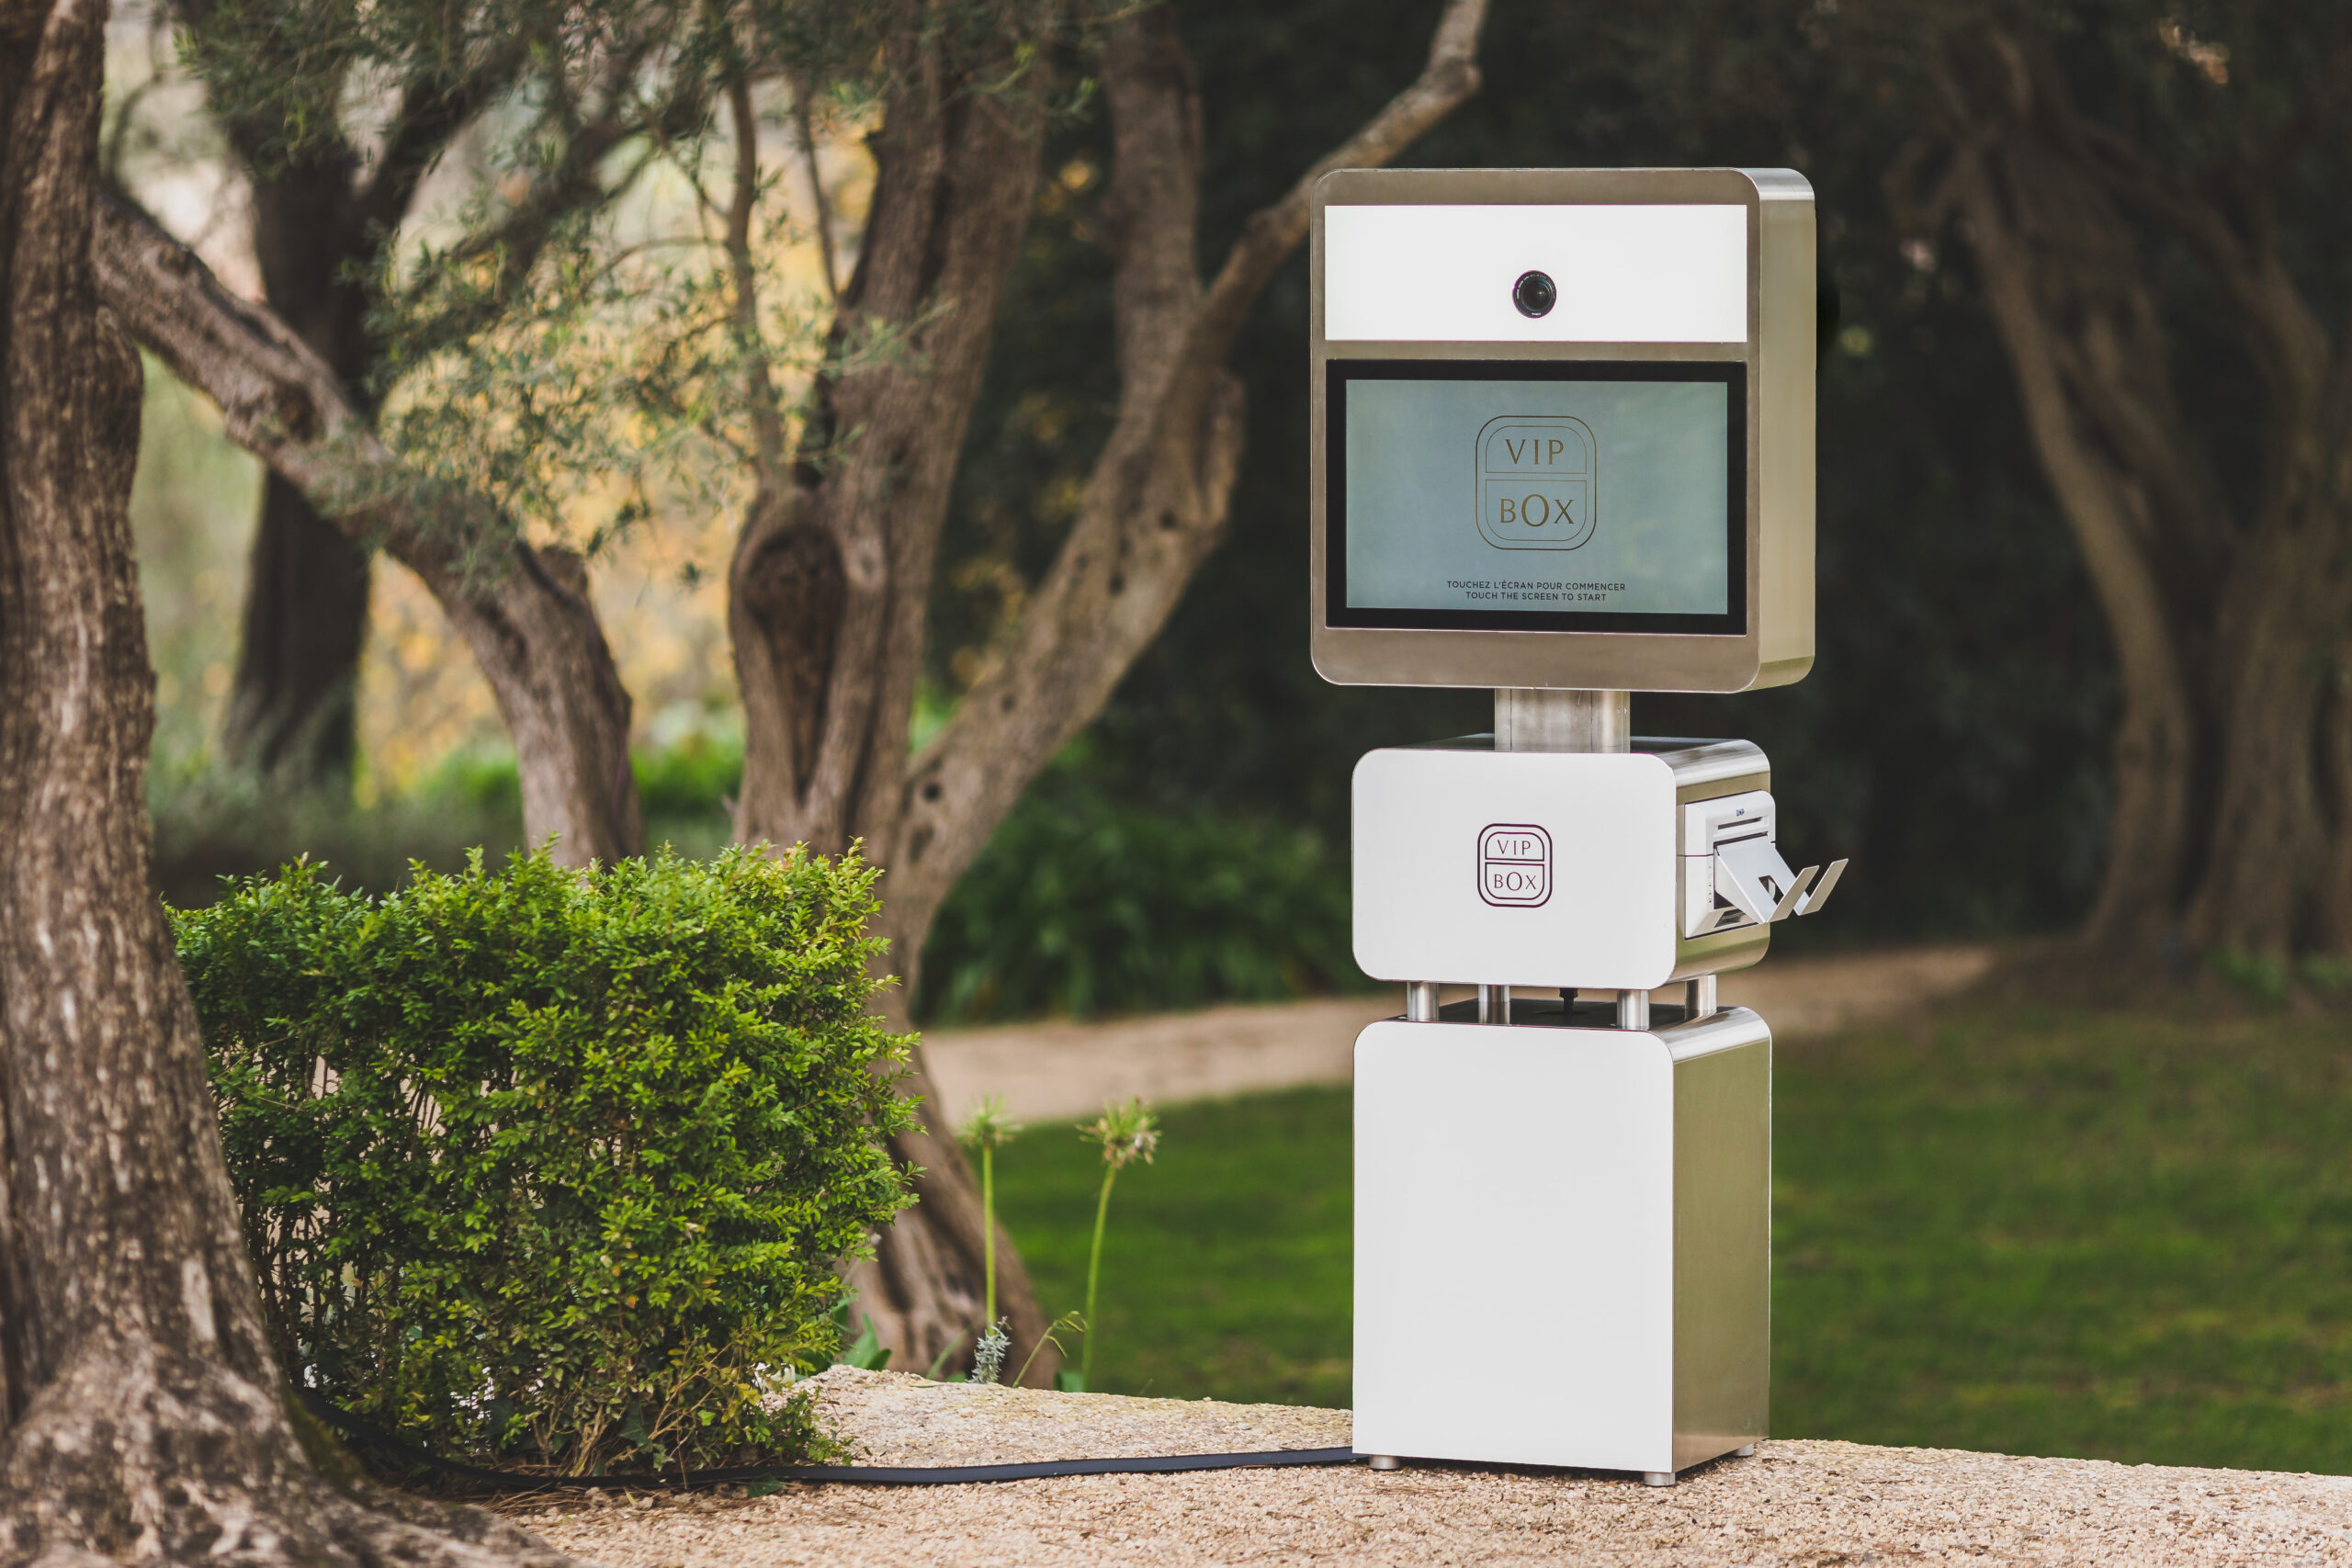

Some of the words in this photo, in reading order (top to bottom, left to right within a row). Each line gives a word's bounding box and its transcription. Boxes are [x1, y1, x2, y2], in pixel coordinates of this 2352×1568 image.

[1505, 438, 1565, 465] VIP
[1499, 493, 1575, 527] BOX
[1447, 581, 1490, 589] TOUCHEZ
[1494, 580, 1533, 590] L'ÉCRAN
[1566, 582, 1625, 591] COMMENCER
[1465, 592, 1498, 600] TOUCH
[1501, 592, 1519, 600] THE
[1521, 592, 1558, 601] SCREEN
[1577, 593, 1607, 602] START
[1498, 840, 1531, 855] VIP
[1494, 872, 1536, 891] BOX
